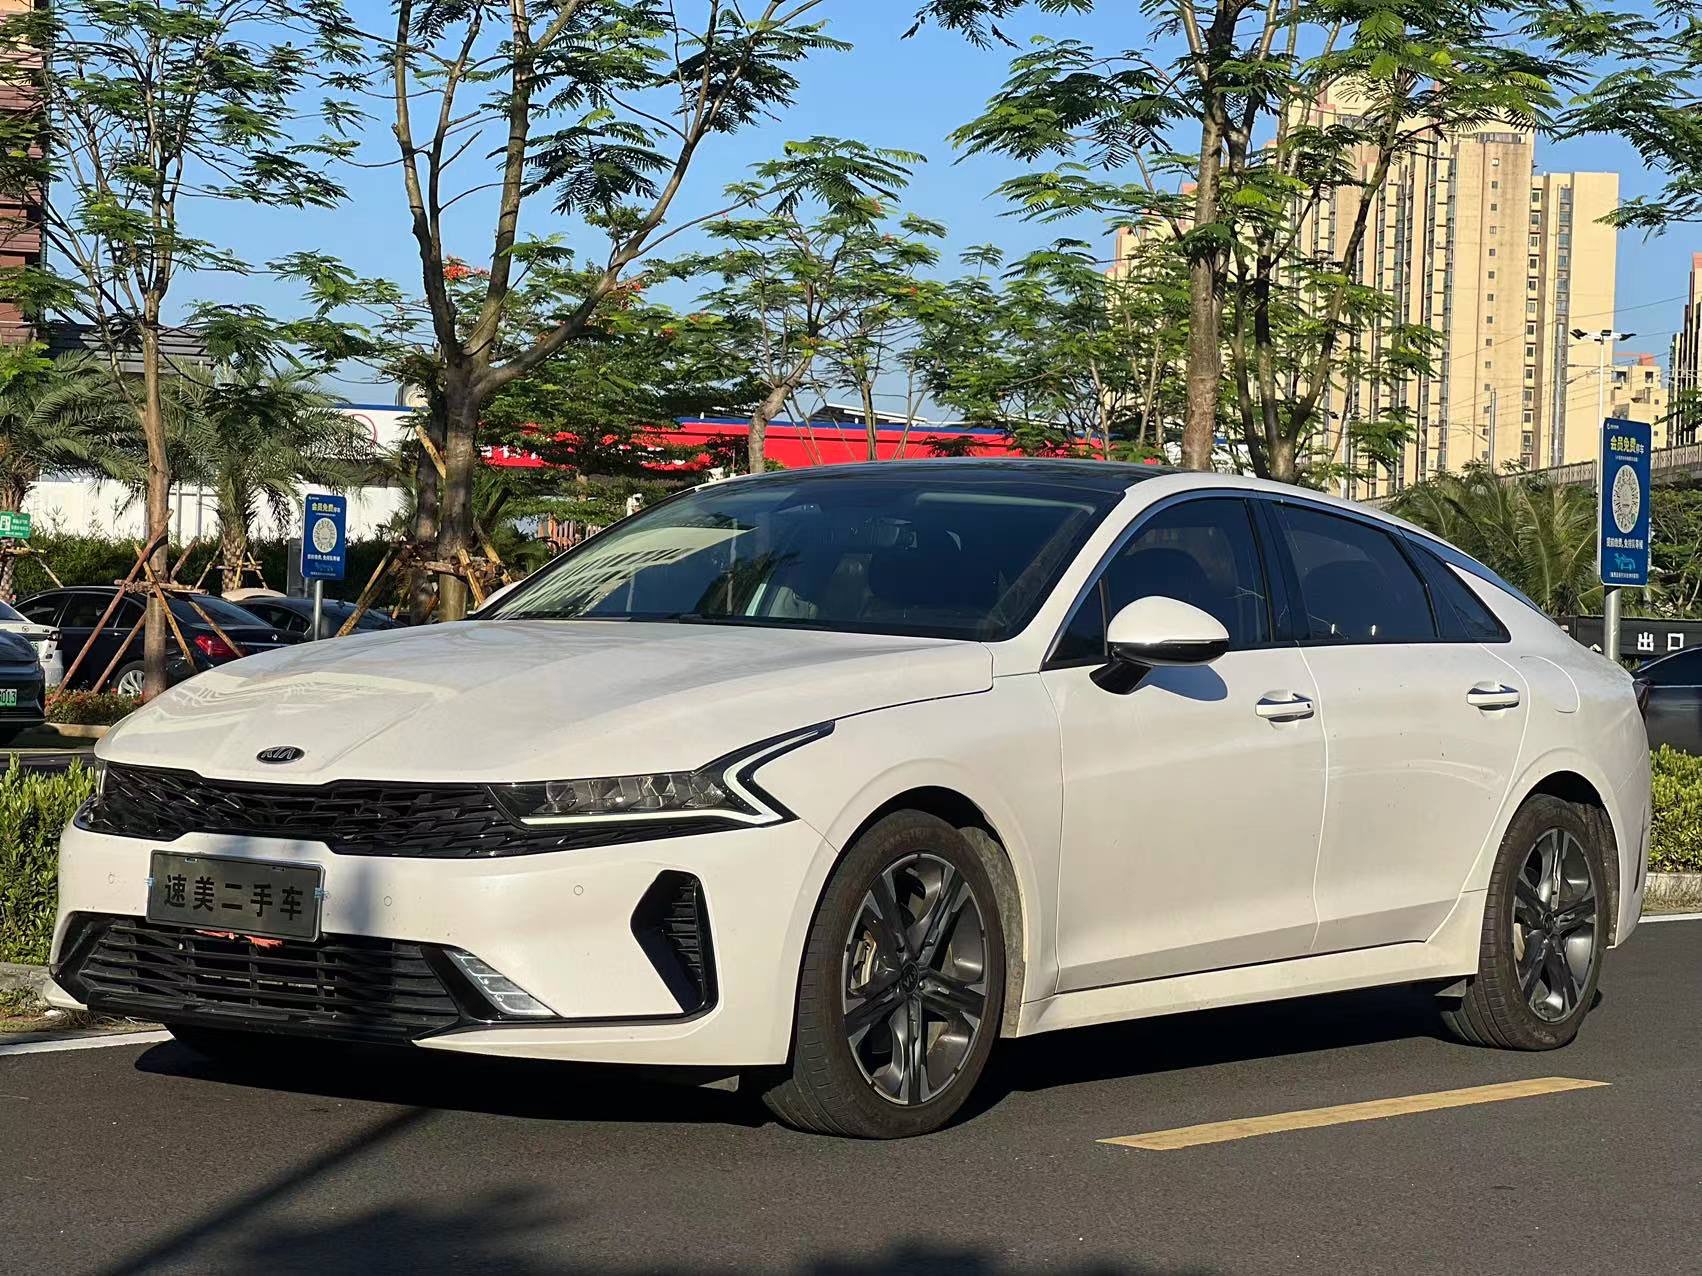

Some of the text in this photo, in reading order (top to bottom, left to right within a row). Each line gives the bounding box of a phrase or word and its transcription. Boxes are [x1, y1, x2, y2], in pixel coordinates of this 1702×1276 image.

[1637, 632, 1685, 651] 出口
[260, 746, 297, 761] KIA
[163, 873, 304, 921] 速美二手车
